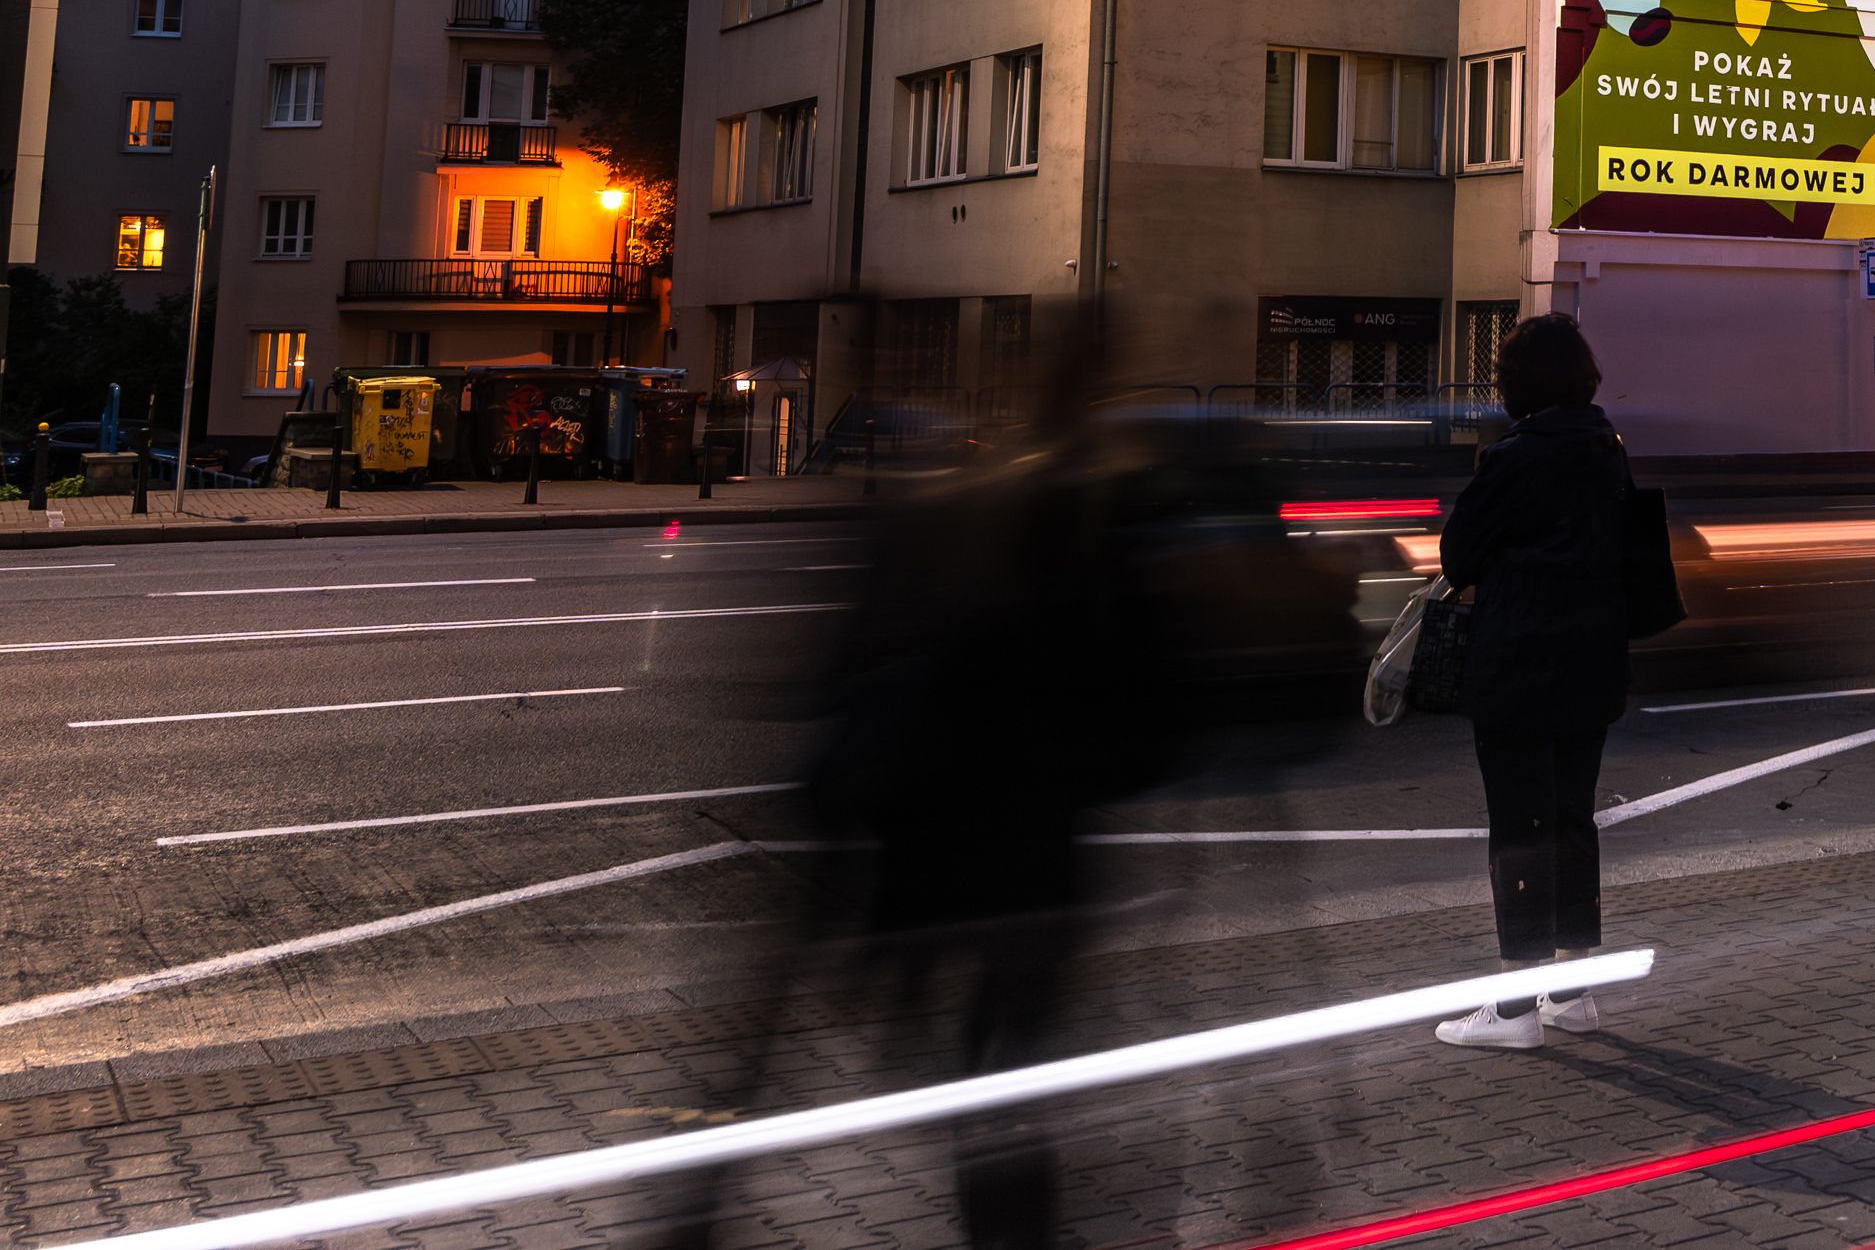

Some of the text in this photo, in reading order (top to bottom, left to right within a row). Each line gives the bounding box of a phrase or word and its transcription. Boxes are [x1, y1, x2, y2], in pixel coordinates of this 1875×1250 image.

[1693, 50, 1793, 81] POKAŻ
[1597, 73, 1678, 102] SWÓJ
[1689, 82, 1772, 109] LETNI
[1671, 113, 1816, 145] I WYGRAJ
[1607, 157, 1677, 187] ROK
[1688, 161, 1865, 195] DARMOWEJ
[1364, 313, 1396, 327] ANG
